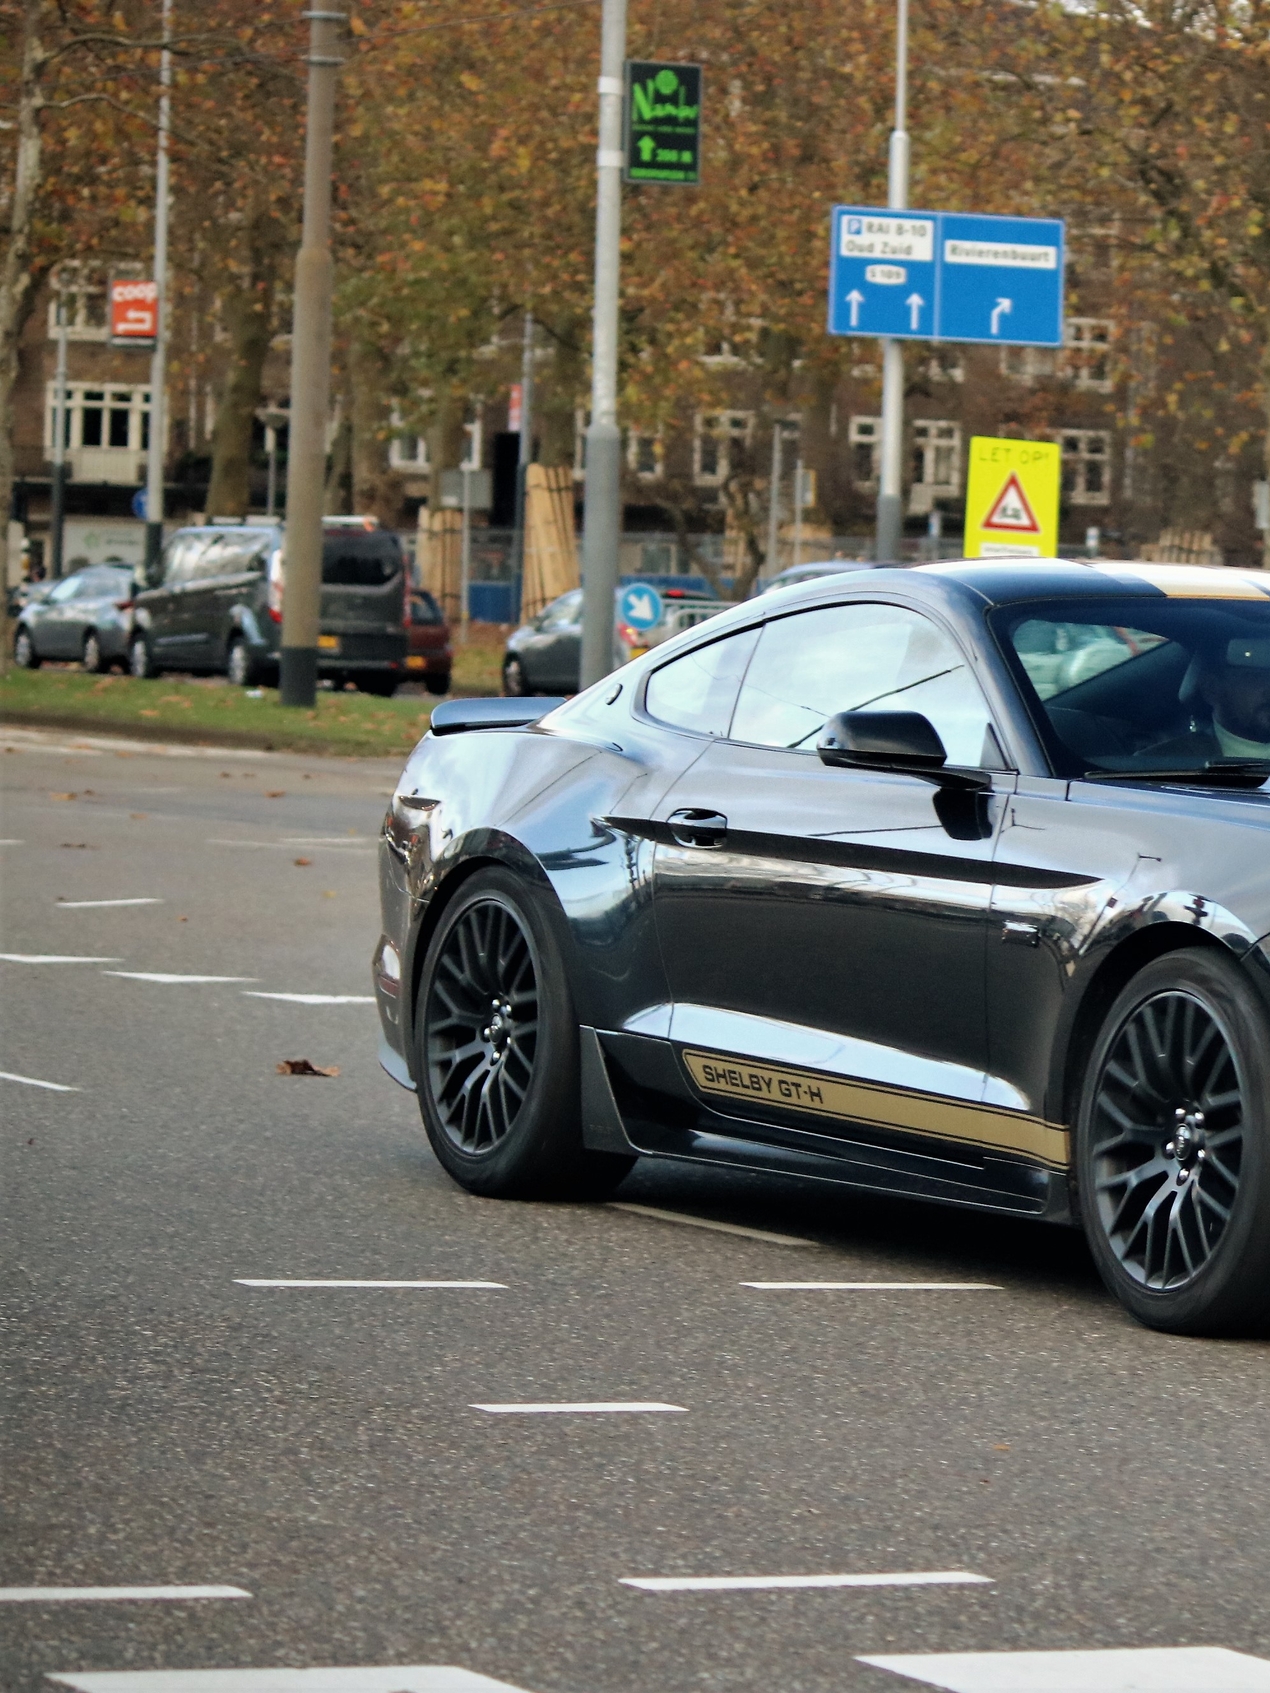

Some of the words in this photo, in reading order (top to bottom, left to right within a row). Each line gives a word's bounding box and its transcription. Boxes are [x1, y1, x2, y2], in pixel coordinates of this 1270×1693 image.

[866, 221, 890, 234] RAI
[896, 223, 927, 237] 8-10
[845, 239, 875, 253] Oud
[880, 241, 912, 255] Zuid
[949, 244, 1050, 262] Rivierenbuurt
[979, 447, 1011, 462] LET
[702, 1064, 772, 1094] SHELBY
[778, 1079, 823, 1104] GT-H
